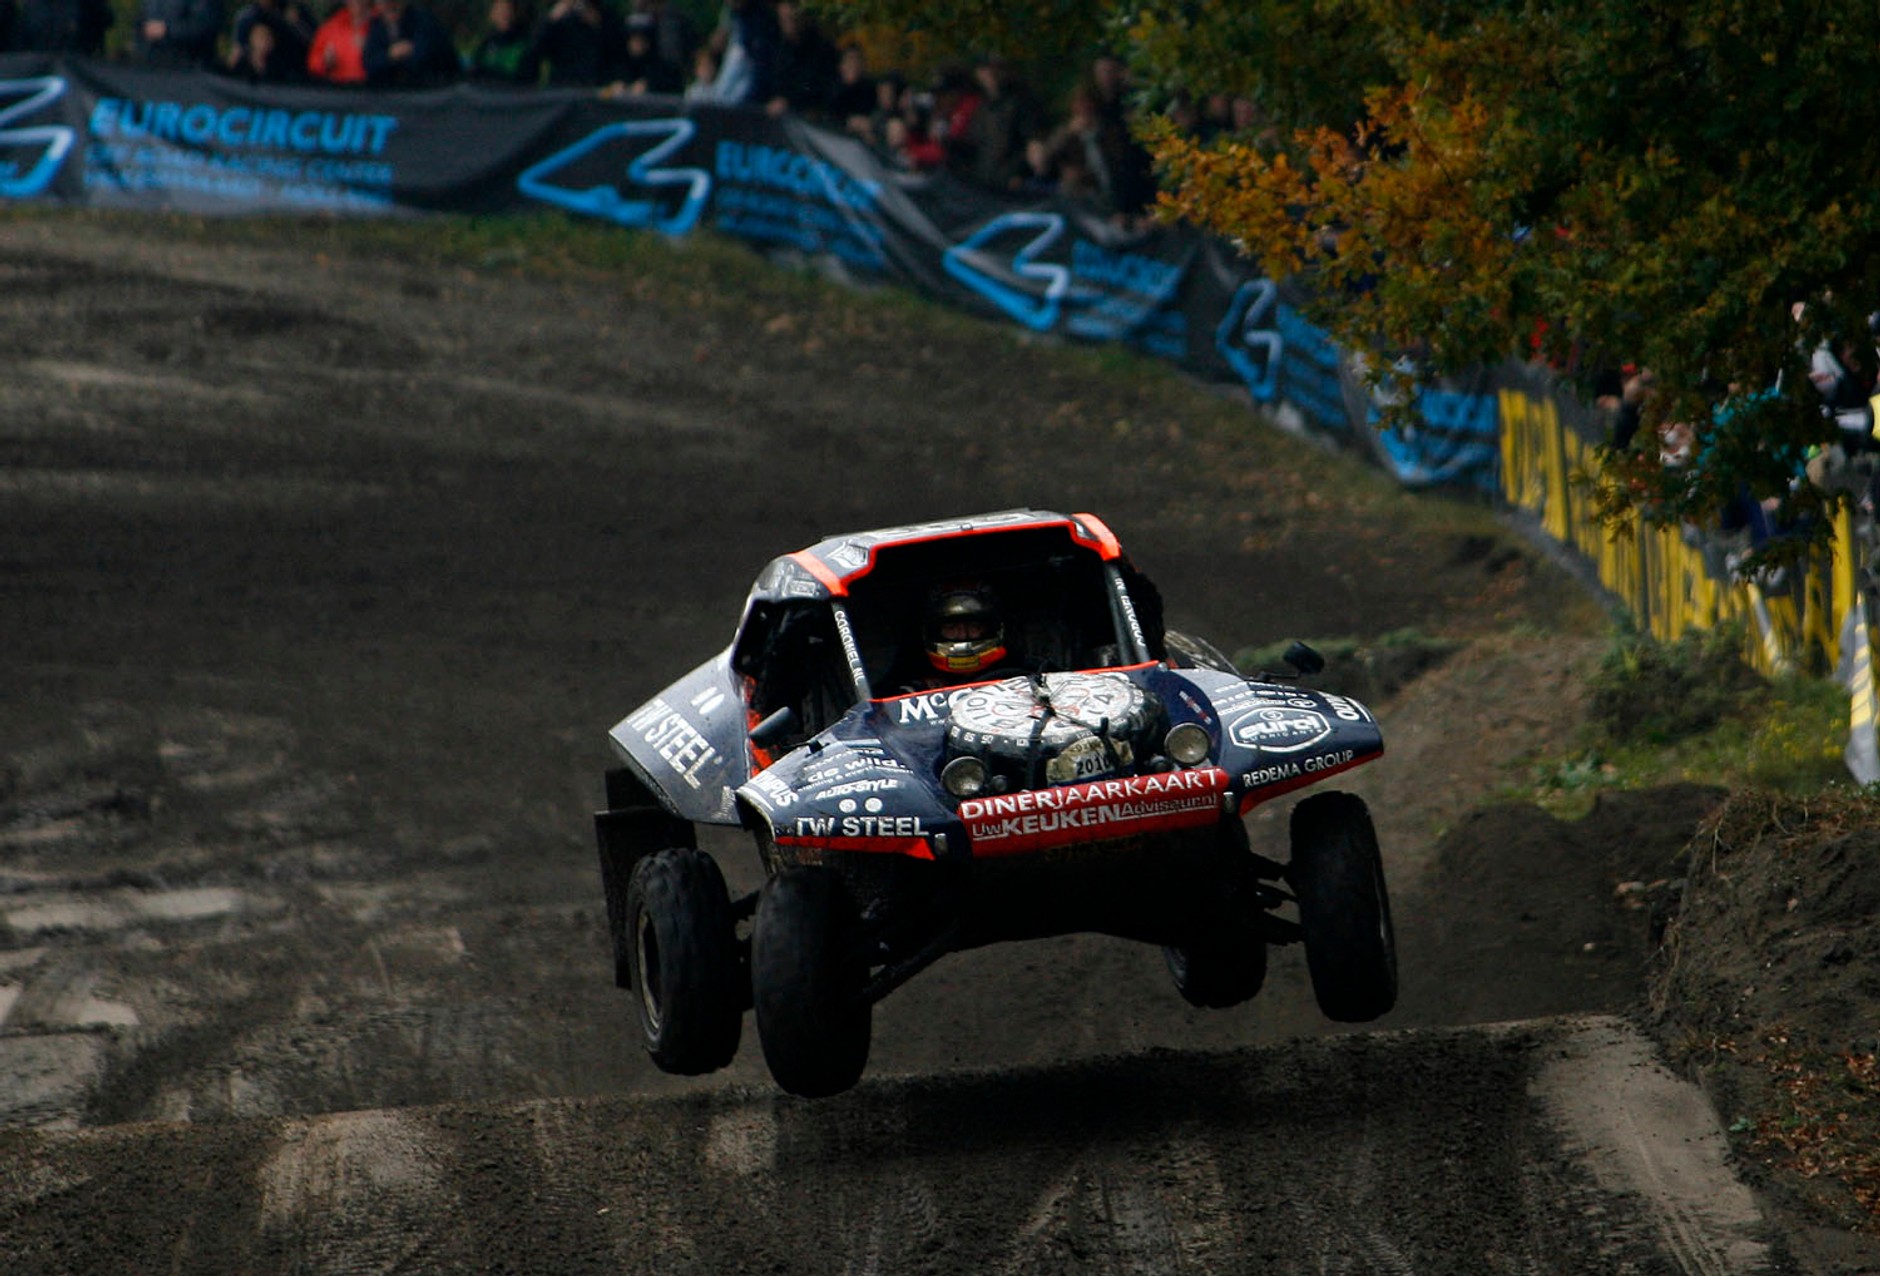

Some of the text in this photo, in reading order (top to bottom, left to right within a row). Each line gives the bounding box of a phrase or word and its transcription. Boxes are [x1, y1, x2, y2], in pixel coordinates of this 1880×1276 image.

[89, 98, 398, 154] EUROCIRCUIT
[644, 711, 718, 790] STEEL
[1242, 749, 1355, 789] REDEMA GROUP
[795, 815, 930, 838] TW STEEL
